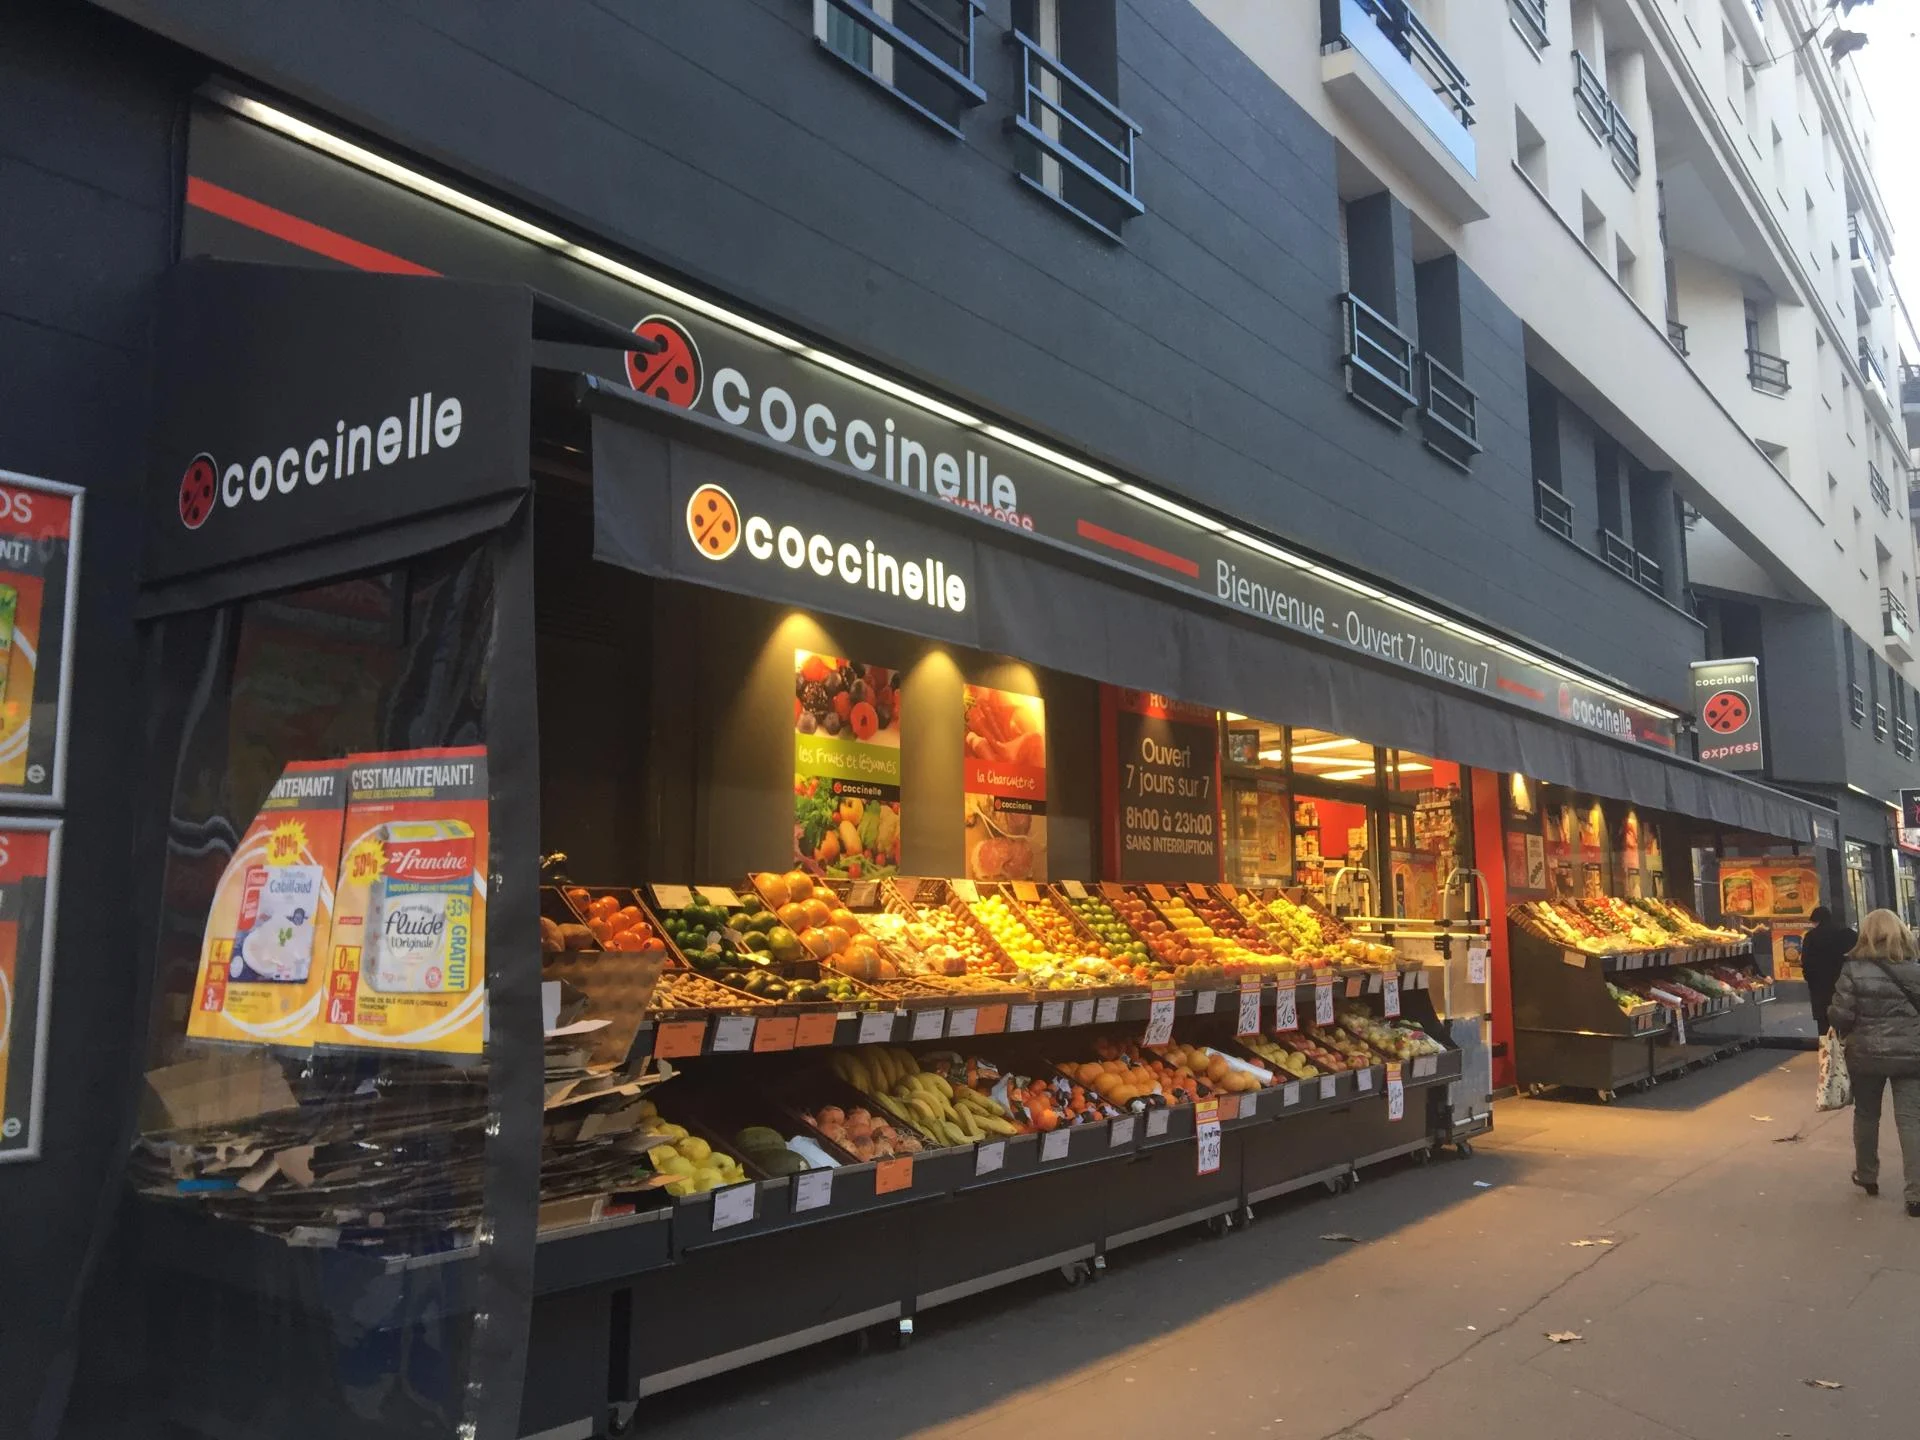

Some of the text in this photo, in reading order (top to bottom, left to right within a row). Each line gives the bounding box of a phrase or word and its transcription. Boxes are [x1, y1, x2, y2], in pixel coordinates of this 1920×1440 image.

[222, 392, 462, 508] coccinelle
[712, 367, 1017, 513] coccinelle
[745, 515, 967, 613] coccinelle
[1216, 559, 1325, 635] Bienvenue
[1346, 611, 1403, 662] Ouvert
[1407, 634, 1416, 663] 7
[1458, 660, 1478, 687] sur
[1481, 662, 1489, 689] 7
[1695, 673, 1756, 687] coccinelle
[1572, 697, 1632, 733] coccinelle
[816, 748, 844, 768] Fruits
[846, 755, 858, 769] et
[1142, 737, 1191, 768] Ouvert
[1701, 740, 1759, 761] express
[352, 764, 474, 790] C'EST MAINTENANT!
[1125, 764, 1210, 799] 7 jours sur 7
[842, 785, 882, 797] coccinelle
[1001, 801, 1033, 812] coccinelle
[1126, 806, 1212, 836] 8h00 à 23h00
[1125, 834, 1213, 855] SANS INTERRUPTION
[396, 848, 467, 874] francine
[270, 878, 312, 894] Cabillaud
[385, 910, 444, 936] fluide
[448, 925, 467, 988] GRATUIT
